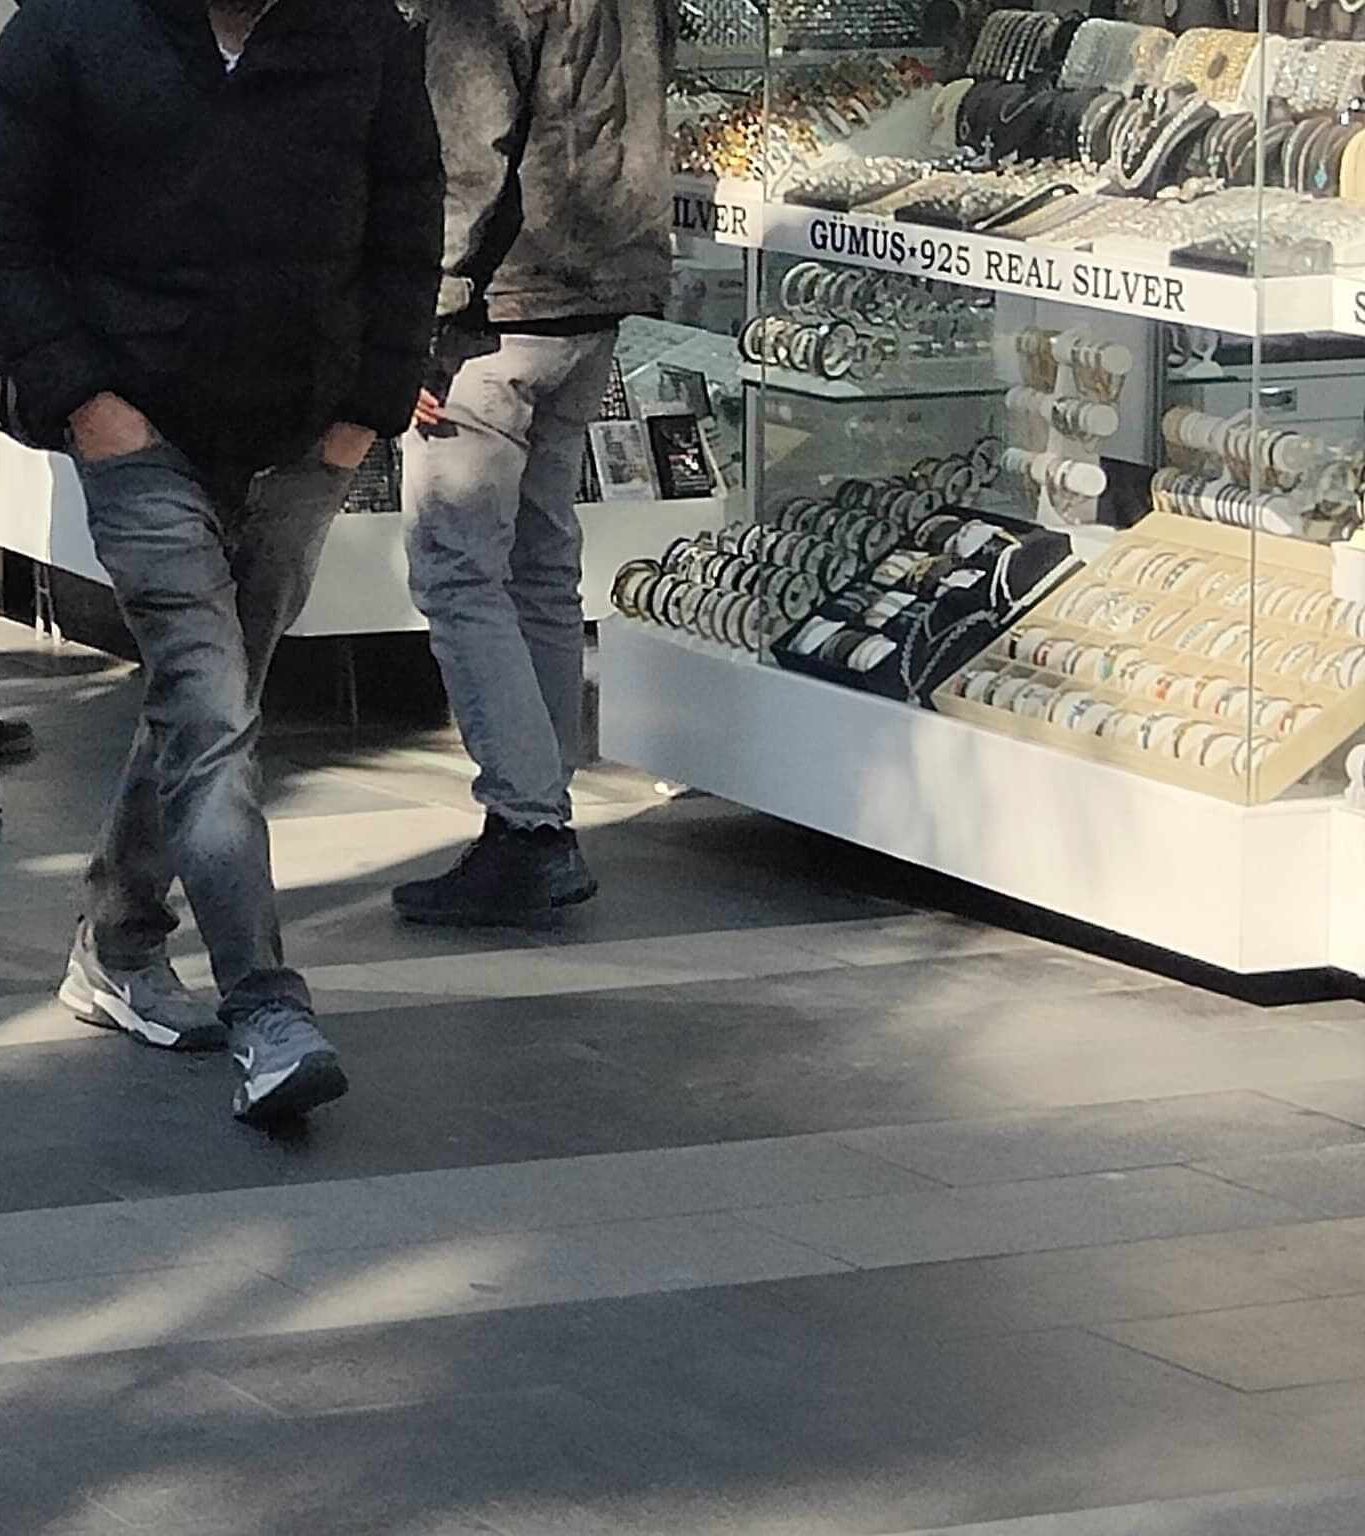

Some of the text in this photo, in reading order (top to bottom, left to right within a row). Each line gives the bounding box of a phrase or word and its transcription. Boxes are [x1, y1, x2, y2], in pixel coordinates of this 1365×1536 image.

[671, 195, 749, 238] ILVER
[810, 215, 1187, 313] GÜMÜŞ 925 REAL SILVER
